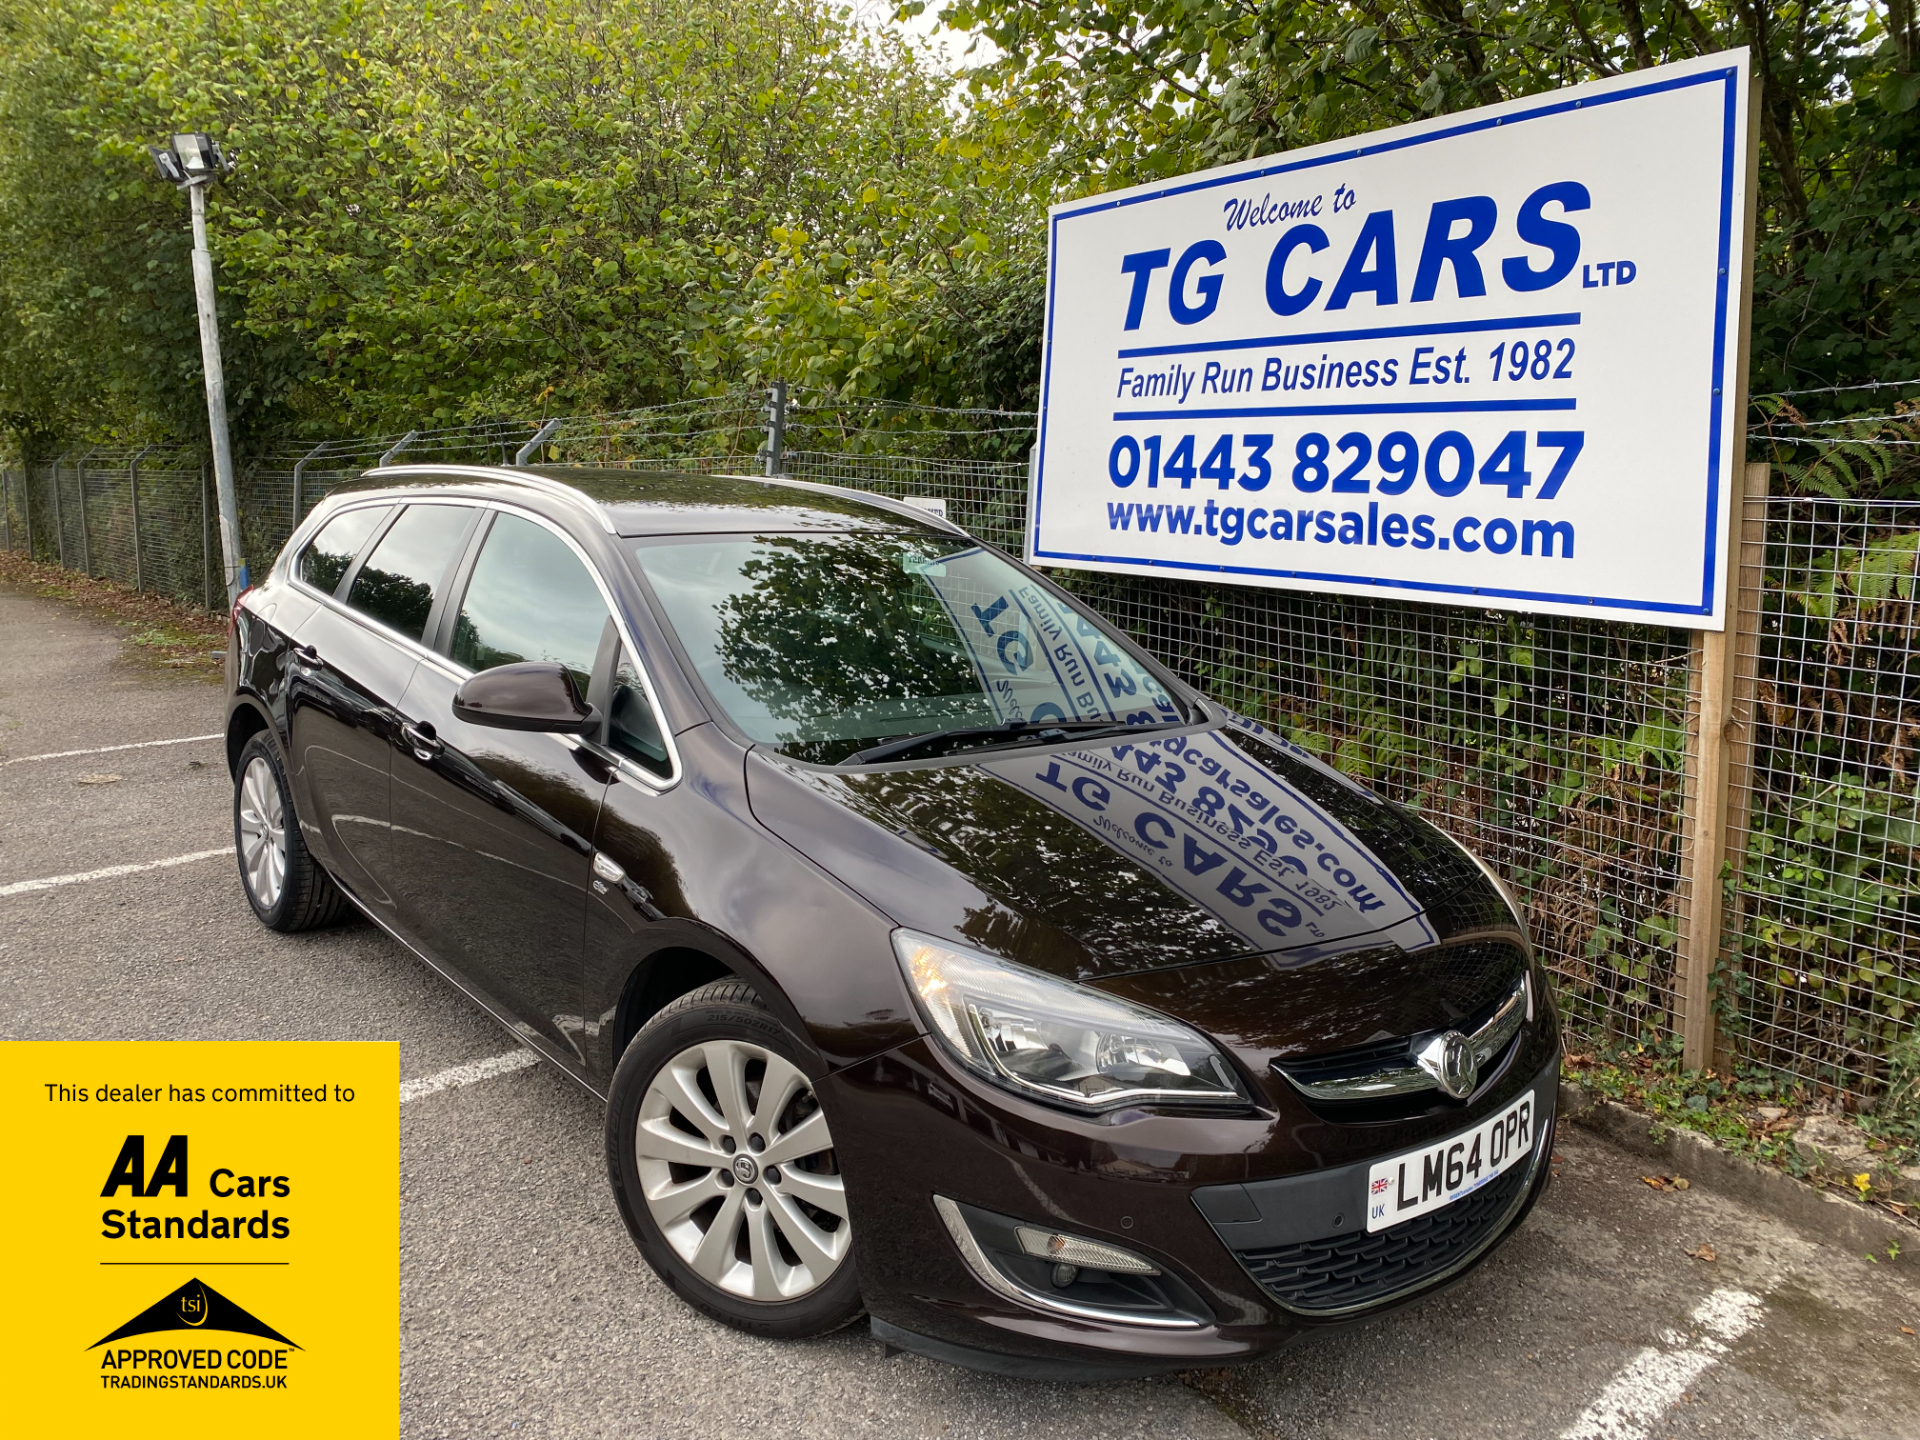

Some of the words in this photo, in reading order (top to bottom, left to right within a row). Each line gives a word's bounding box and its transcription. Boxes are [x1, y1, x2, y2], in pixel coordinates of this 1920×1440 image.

[1223, 195, 1322, 231] Welcome
[1332, 183, 1356, 213] to
[1121, 239, 1228, 332] TG
[1264, 180, 1592, 317] CARS
[1582, 260, 1637, 289] LTD
[1117, 364, 1196, 405] Family
[1201, 361, 1254, 395] Run
[1261, 353, 1399, 392] Business
[1409, 346, 1471, 386] Est.
[1489, 337, 1576, 382] 1982
[1108, 433, 1274, 492] 01443
[1291, 430, 1585, 500] 829047
[1107, 499, 1575, 559] www.tgcarsales.com
[707, 1014, 781, 1035] 215/50ZR17
[1397, 1132, 1482, 1211] LM64
[1490, 1100, 1530, 1168] OPR
[1371, 1204, 1386, 1219] UK
